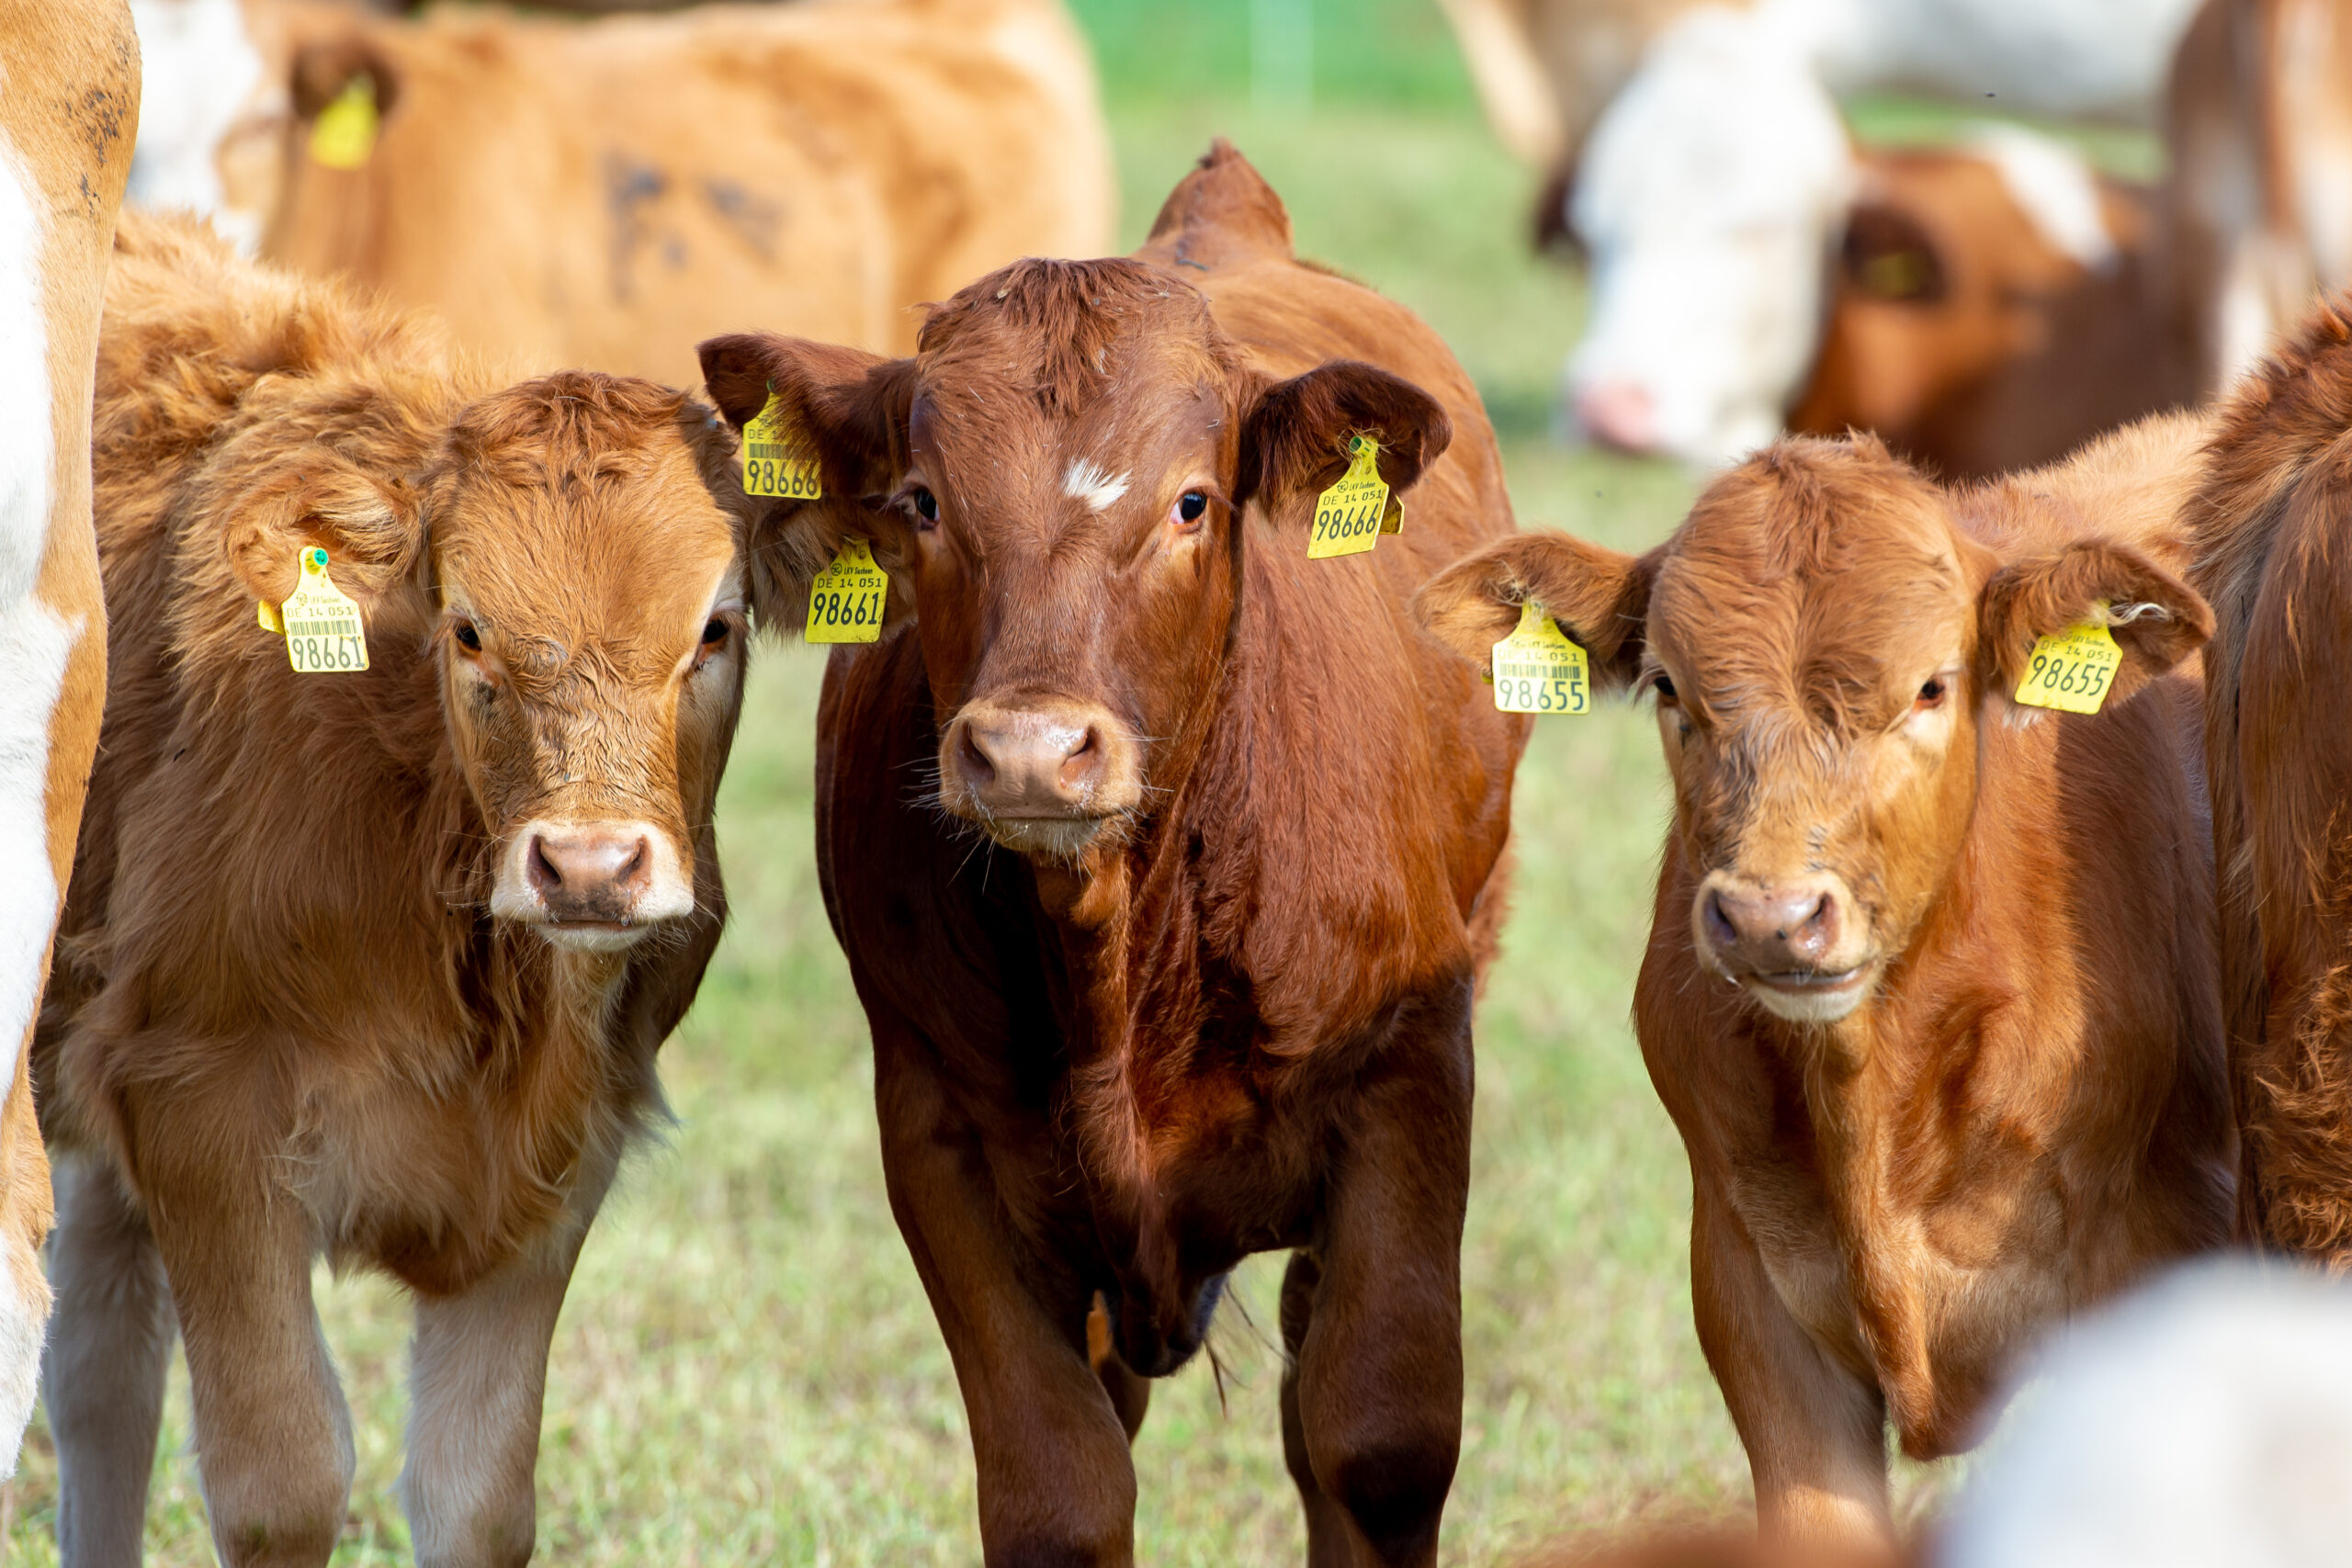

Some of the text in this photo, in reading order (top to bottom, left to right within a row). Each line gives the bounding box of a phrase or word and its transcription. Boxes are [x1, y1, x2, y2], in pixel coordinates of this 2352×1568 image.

[749, 429, 764, 439] DE
[748, 460, 817, 496] 98666
[1323, 490, 1382, 505] DE 14 051
[1317, 503, 1379, 541] 98666
[843, 567, 854, 575] LKV
[818, 578, 882, 588] DE 14 051
[287, 606, 354, 617] DE 14 051
[813, 592, 879, 626] 98661
[292, 636, 365, 670] 98661
[1550, 652, 1579, 662] 051
[2041, 639, 2112, 661] DE 14 051
[2029, 655, 2109, 696] 98655
[1498, 679, 1584, 711] 98655
